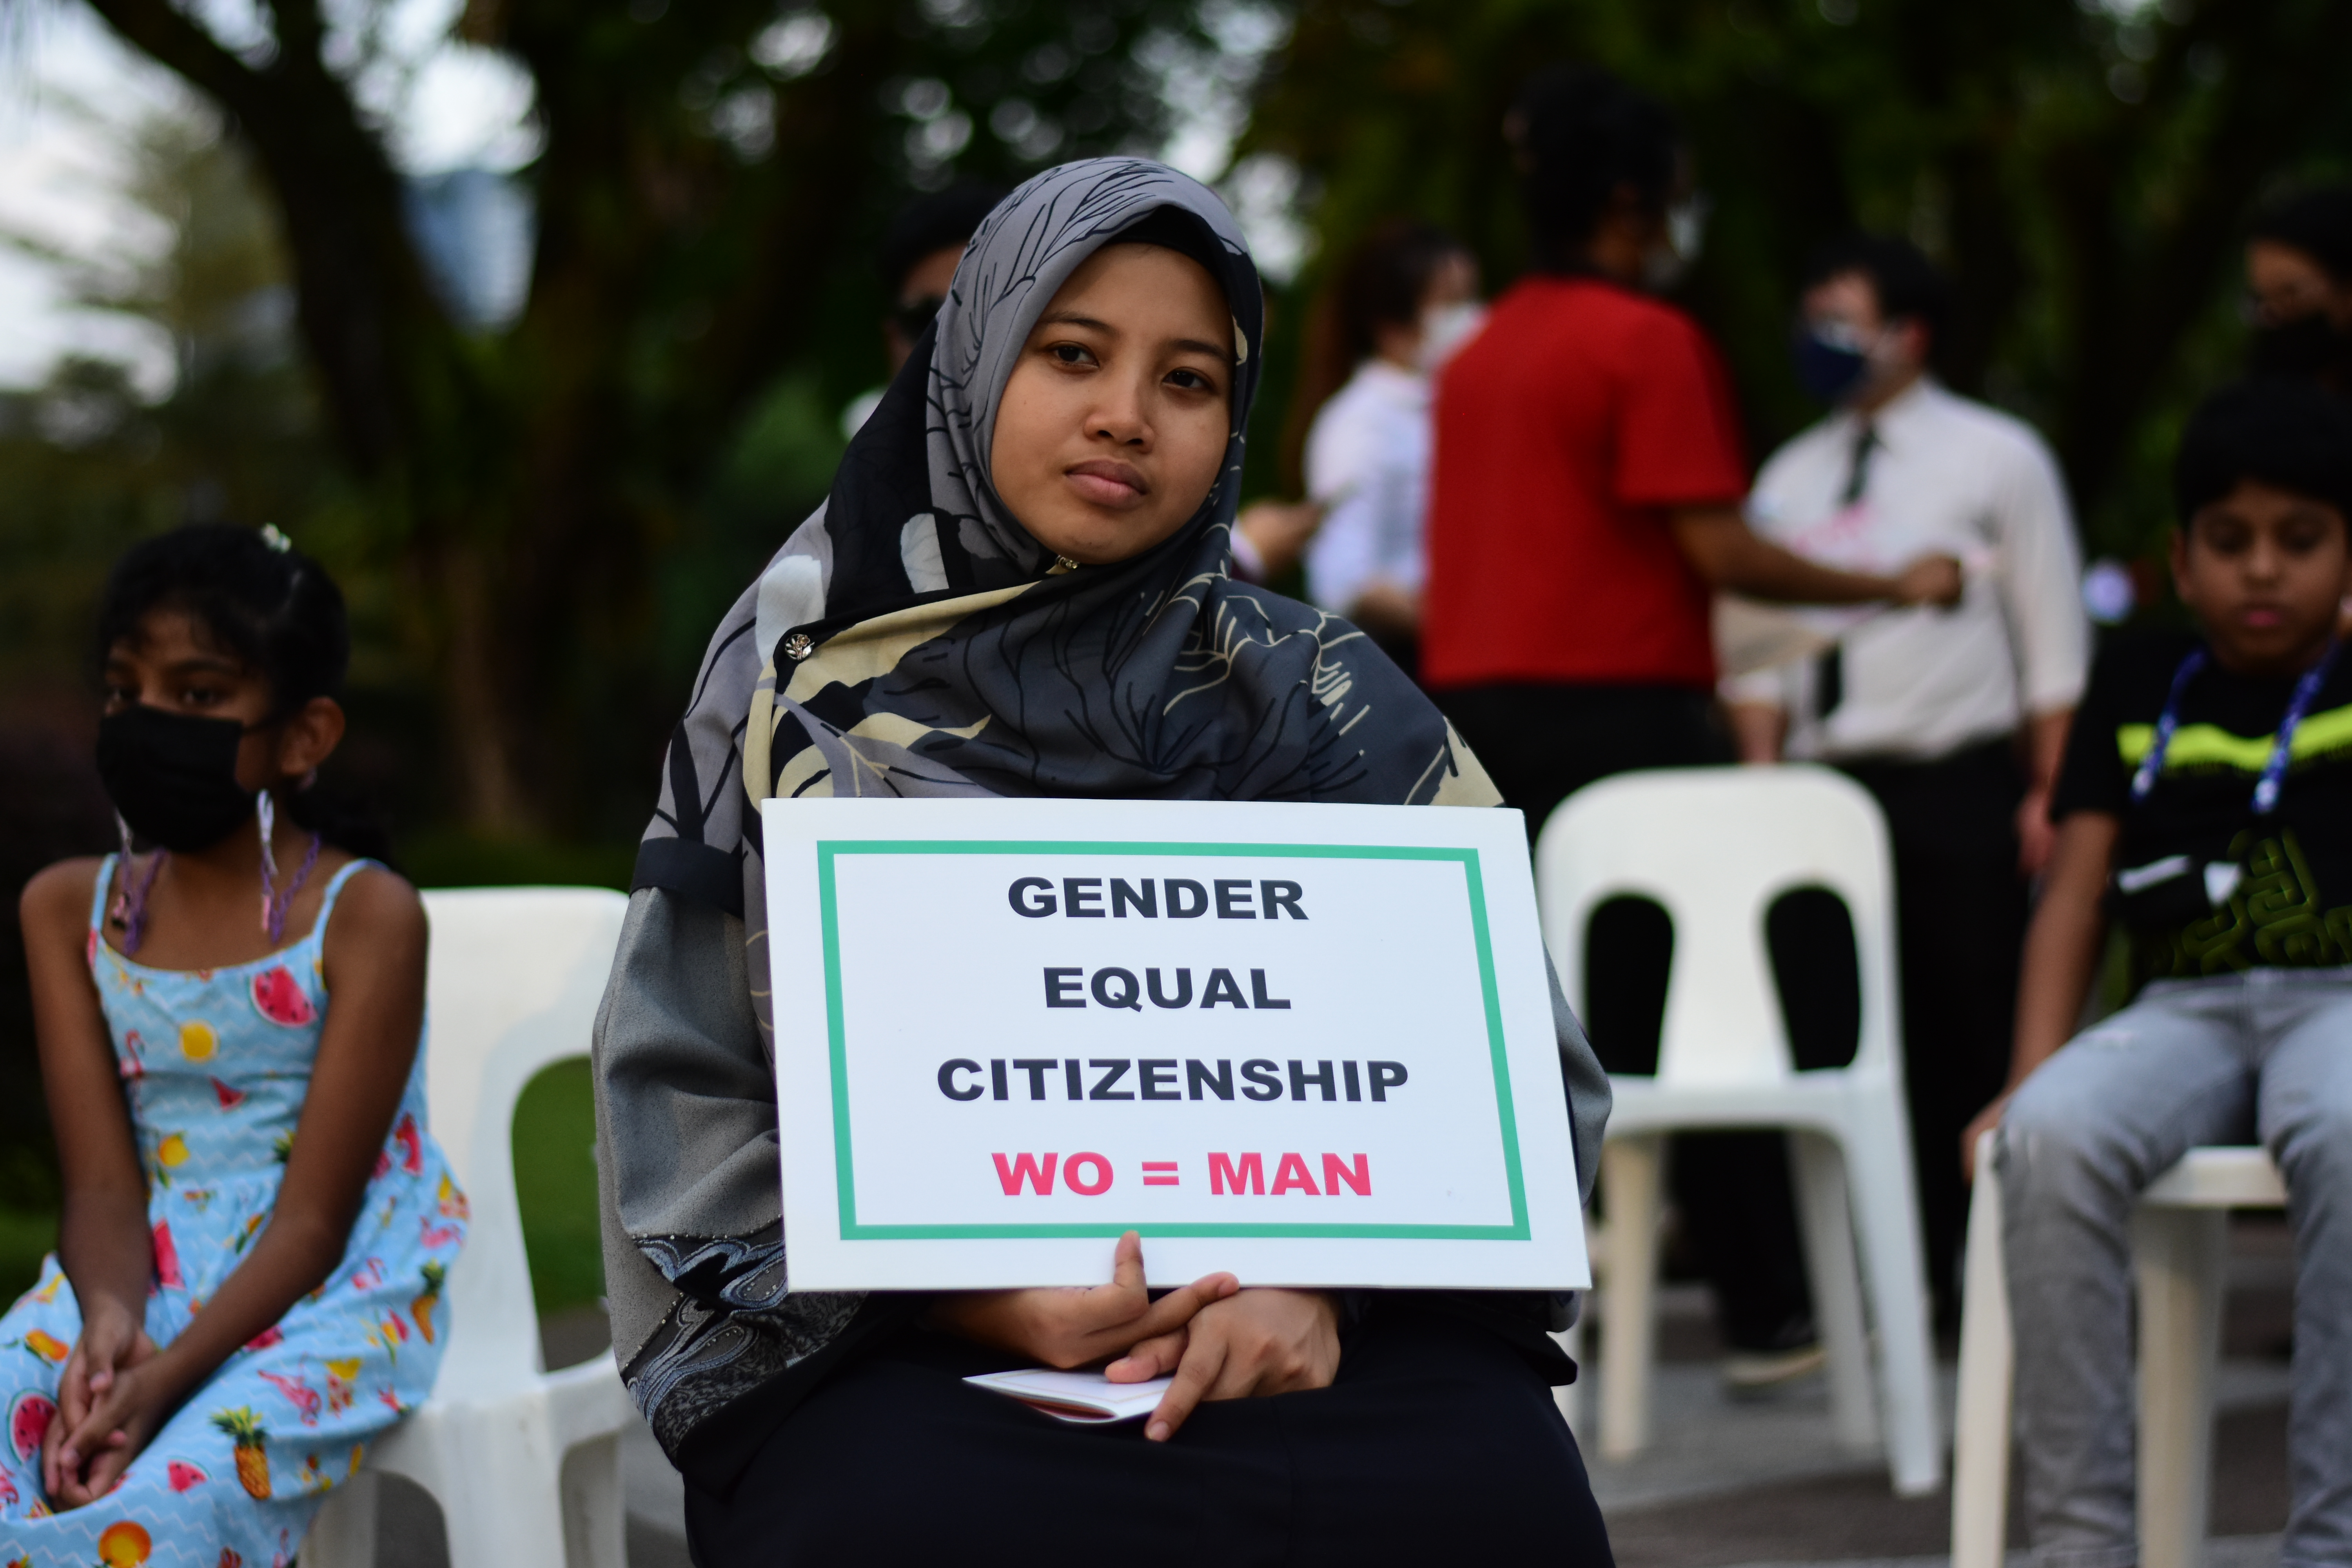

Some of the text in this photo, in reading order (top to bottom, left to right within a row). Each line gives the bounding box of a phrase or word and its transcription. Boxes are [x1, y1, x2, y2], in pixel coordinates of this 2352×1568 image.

[1008, 878, 1307, 920] GENDER
[1044, 968, 1291, 1012] EQUAL
[937, 1060, 1408, 1102] CITIZENSHIP
[992, 1152, 1372, 1196] WO = MAN
